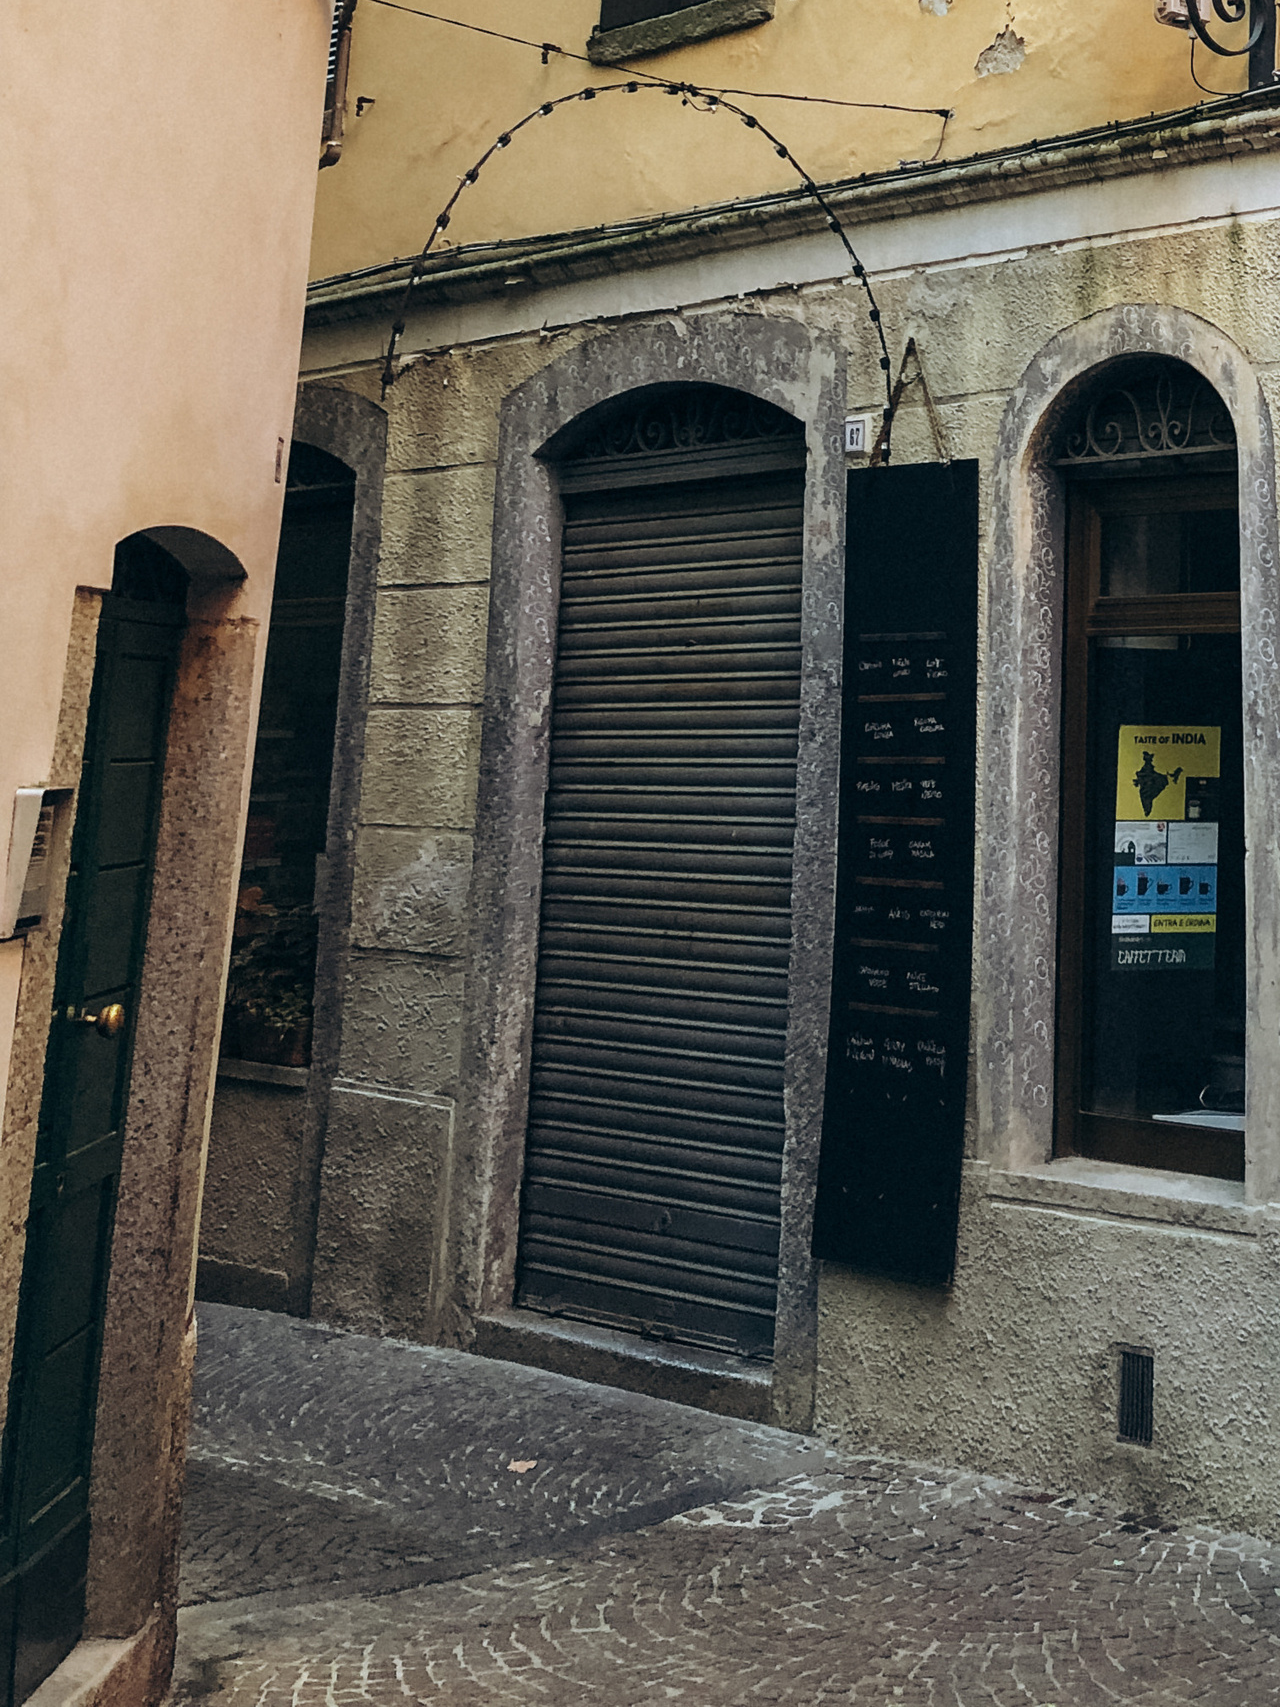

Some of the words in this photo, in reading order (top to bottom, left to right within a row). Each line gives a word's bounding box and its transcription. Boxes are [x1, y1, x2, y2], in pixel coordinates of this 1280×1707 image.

[849, 427, 860, 446] 67
[1133, 735, 1157, 745] TASTE
[1158, 735, 1170, 745] OF
[1171, 732, 1207, 746] INDIA
[1153, 918, 1178, 928] ENTRA
